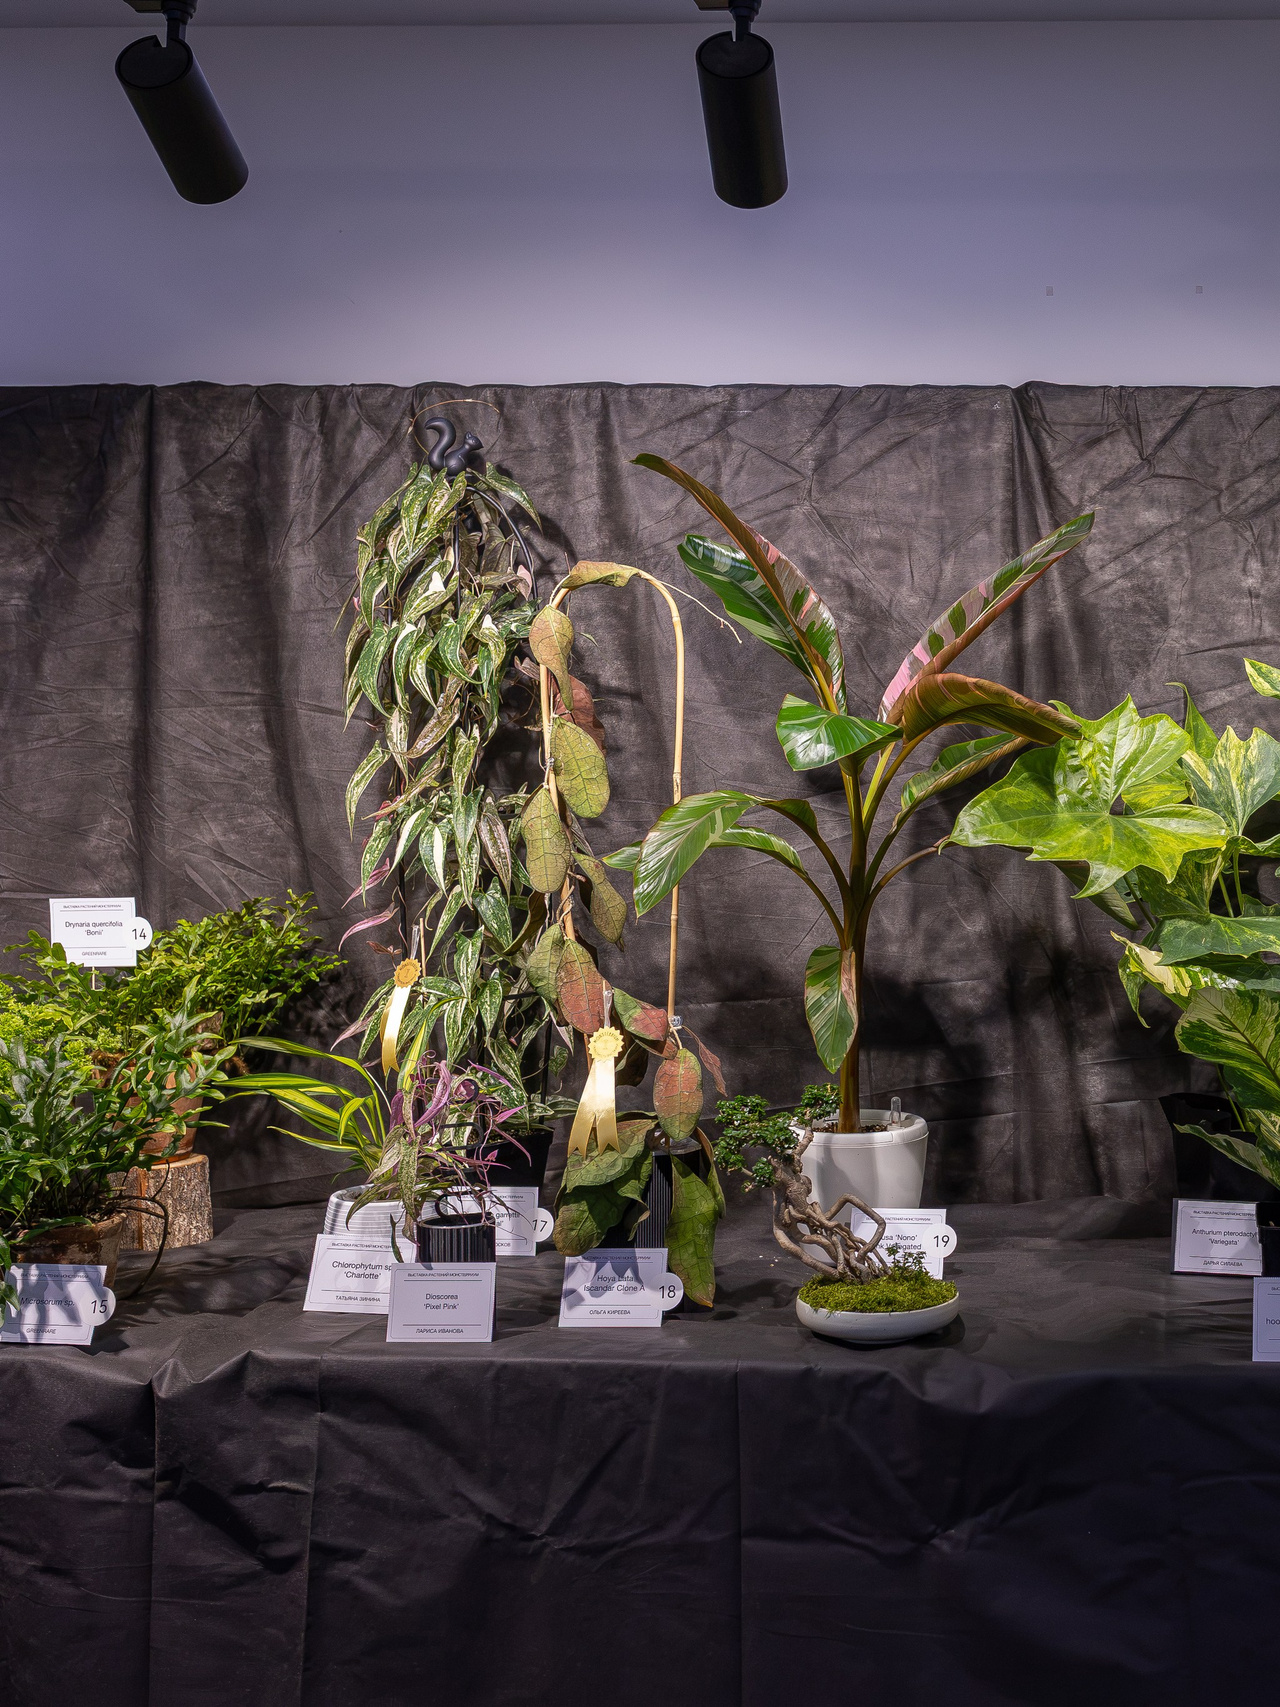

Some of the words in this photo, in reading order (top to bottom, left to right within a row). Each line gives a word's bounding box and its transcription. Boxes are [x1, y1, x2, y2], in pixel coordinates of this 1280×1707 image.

[132, 928, 146, 940] 14
[532, 1219, 547, 1233] 17
[934, 1235, 950, 1247] 19
[332, 1261, 382, 1270] Chlorophytum
[659, 1285, 676, 1298] 18
[21, 1297, 62, 1306] Microsorum
[91, 1300, 107, 1314] 15
